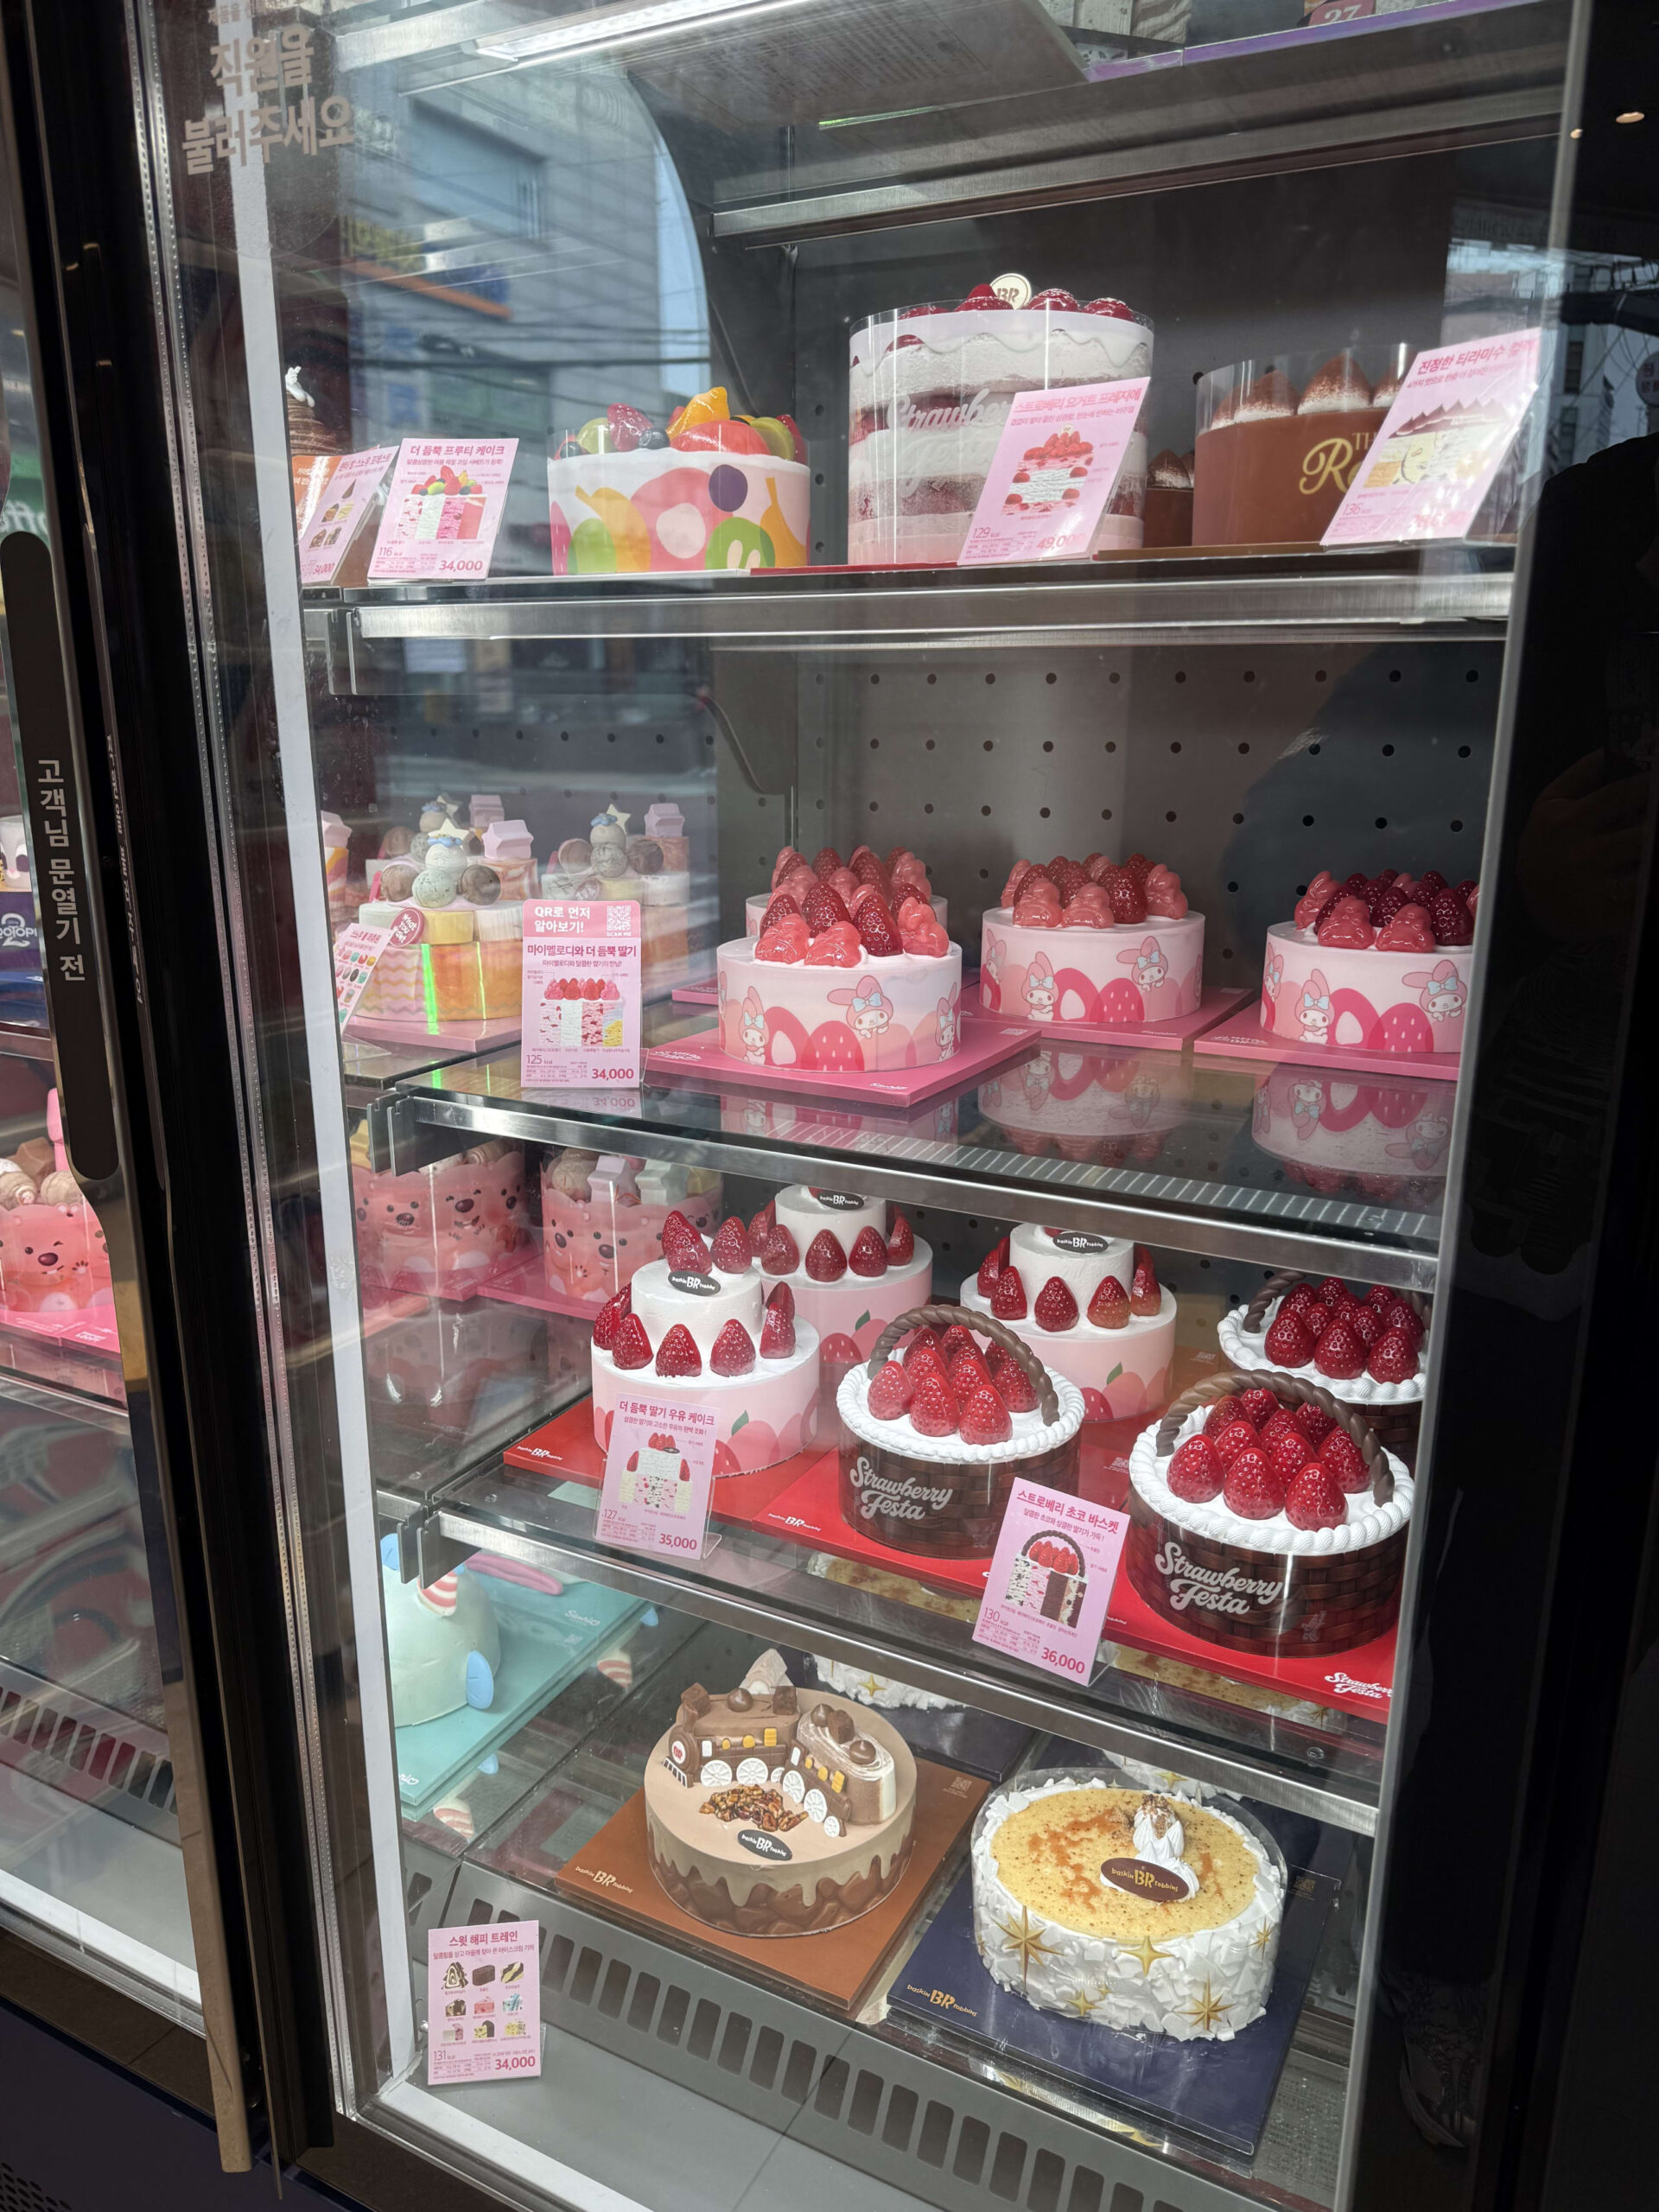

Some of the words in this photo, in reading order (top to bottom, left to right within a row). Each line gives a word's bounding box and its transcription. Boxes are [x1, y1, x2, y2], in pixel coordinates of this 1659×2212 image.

[210, 26, 314, 97] 직원을
[182, 94, 355, 175] 불러주세요
[1418, 354, 1453, 375] 진정한
[1456, 345, 1505, 366] 티라미수
[1013, 397, 1065, 412] 스트로베리
[1065, 395, 1097, 408] 요거트
[410, 446, 420, 455] 더
[423, 446, 442, 456] 듬뿍
[443, 446, 474, 455] 프루티
[475, 446, 505, 455] 케이크
[973, 527, 990, 538] 129
[378, 547, 393, 556] 116
[438, 560, 483, 572] 34,000
[37, 760, 70, 848] 고객님
[48, 858, 81, 945] 문열기
[534, 906, 564, 918] QR로
[568, 906, 590, 919] 먼저
[534, 920, 584, 934] 알아보기!
[527, 944, 583, 957] 마이멜로디와
[586, 945, 595, 957] 더
[597, 945, 616, 957] 듬뿍
[618, 945, 637, 957] 딸기
[60, 954, 86, 982] 전
[526, 1055, 543, 1065] 125
[592, 1068, 634, 1081] 34,000
[833, 1195, 845, 1205] BR
[1072, 1236, 1087, 1249] BR
[686, 1276, 700, 1289] BR
[620, 1401, 628, 1412] 더
[630, 1402, 647, 1415] 듬뿍
[649, 1405, 666, 1418] 딸기
[669, 1408, 686, 1421] 우유
[688, 1412, 715, 1426] 케이크
[531, 1448, 550, 1458] BR
[849, 1456, 953, 1510] Strawberry
[861, 1489, 925, 1521] Festa
[1017, 1490, 1065, 1516] 스트로베리
[1065, 1506, 1086, 1522] 초코
[1088, 1513, 1120, 1535] 바스켓
[604, 1509, 618, 1520] 127
[785, 1516, 805, 1527] BR
[658, 1533, 697, 1550] 35,000
[1154, 1541, 1283, 1605] Strawberry
[1169, 1578, 1249, 1615] Festa
[983, 1606, 1001, 1623] 130
[1040, 1647, 1085, 1674] 36,000
[1333, 1682, 1382, 1699] Festa
[756, 1837, 772, 1852] BR
[593, 1871, 616, 1886] BR
[1111, 1867, 1134, 1879] baskin
[1135, 1869, 1155, 1888] BR
[1154, 1880, 1179, 1892] robbins
[449, 1935, 467, 1947] 스윗
[470, 1933, 488, 1945] 해피
[491, 1930, 518, 1944] 트레인
[907, 1984, 931, 1998] baskin
[930, 1989, 955, 2009] BR
[434, 2050, 446, 2061] 131
[495, 2056, 536, 2071] 34,000
